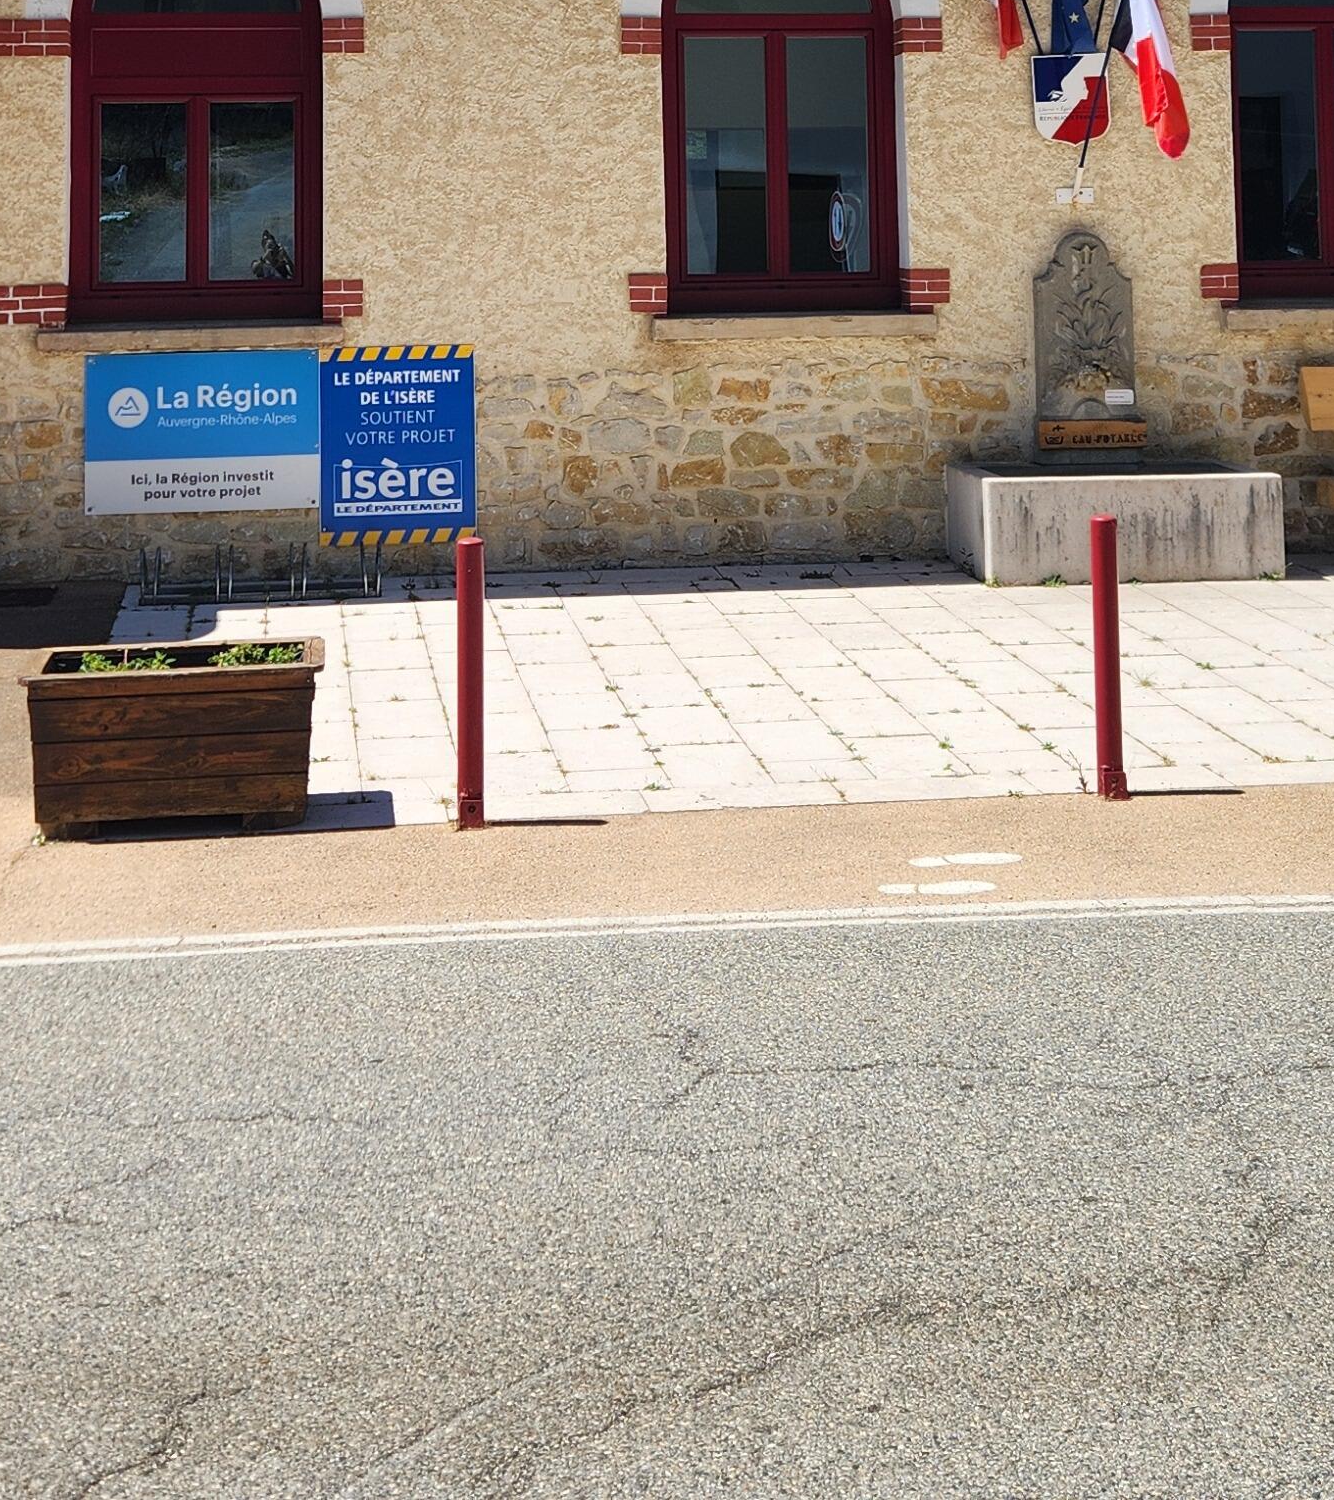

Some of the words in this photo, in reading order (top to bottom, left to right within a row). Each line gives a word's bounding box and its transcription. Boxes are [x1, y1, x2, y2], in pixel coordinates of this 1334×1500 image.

[334, 372, 351, 386] LE
[355, 368, 461, 385] DÉPARTEMENT
[156, 386, 189, 410] La
[197, 382, 298, 413] Région
[360, 391, 380, 405] DE
[157, 412, 298, 429] Auvergne-Rhône-Alpes
[360, 409, 436, 426] SOUTIENT
[345, 430, 396, 446] VOTRE
[401, 428, 456, 444] PROJET
[130, 474, 153, 486] Ici,
[155, 472, 168, 485] la
[171, 472, 220, 486] Région
[223, 469, 275, 483] investit
[341, 457, 456, 500] isère
[143, 489, 177, 502] pour
[179, 486, 217, 498] votre
[219, 484, 262, 499] projet
[336, 506, 353, 514] LE
[355, 502, 461, 514] DÉPARTEMENT
